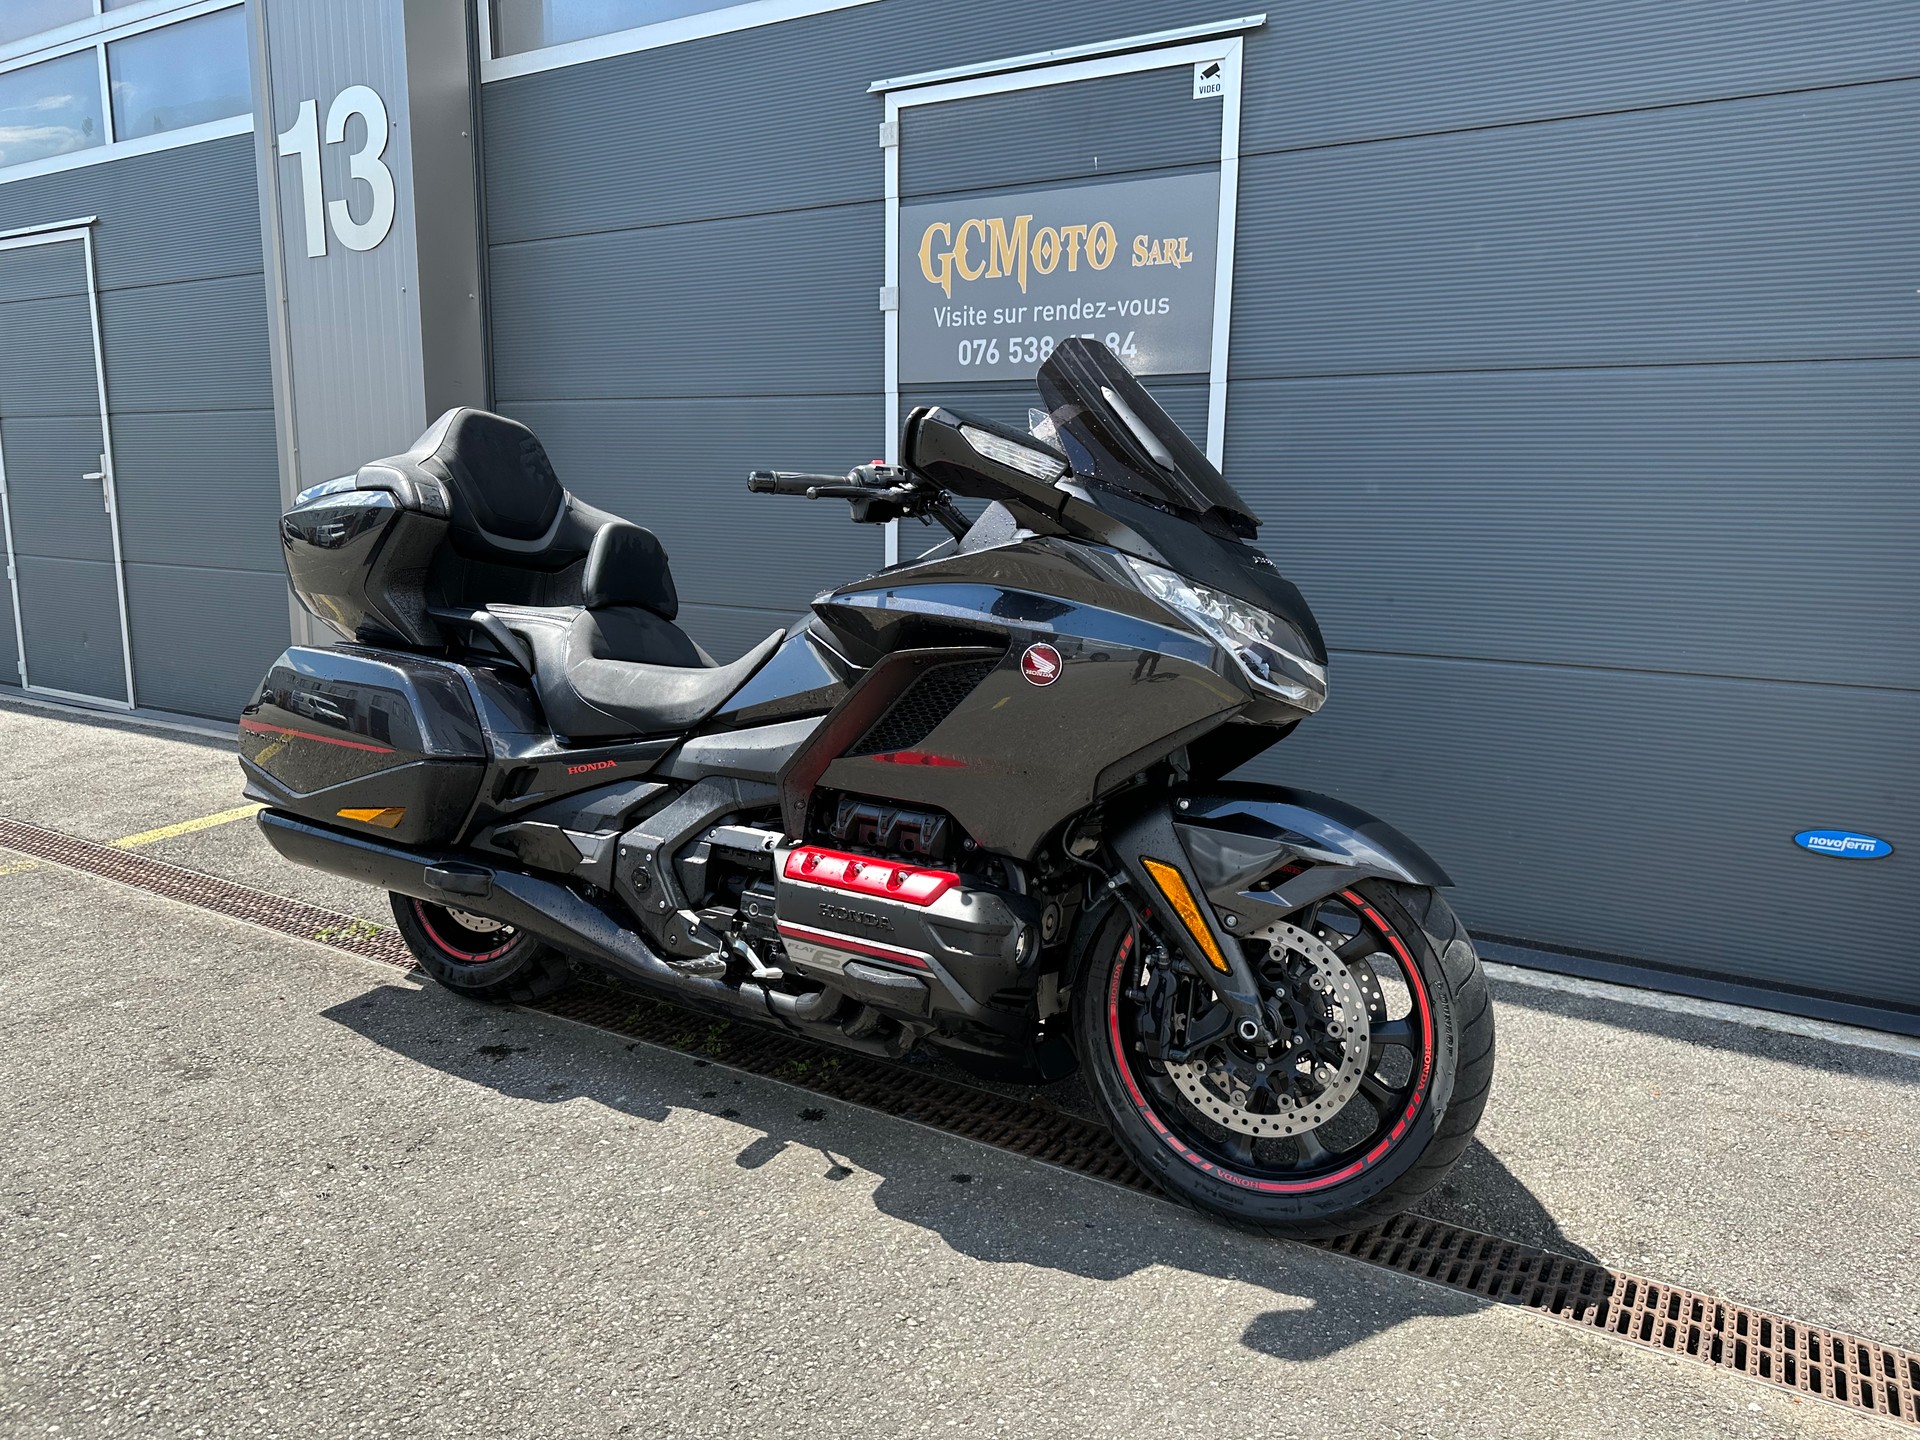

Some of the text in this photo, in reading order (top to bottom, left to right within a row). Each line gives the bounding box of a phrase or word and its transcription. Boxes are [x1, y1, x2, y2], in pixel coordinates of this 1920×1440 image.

[1198, 83, 1221, 94] VIDEO
[278, 84, 395, 258] 13
[933, 297, 1170, 328] Visite sur rendez-vous
[958, 338, 1000, 366] 076
[1008, 335, 1055, 363] 538
[1025, 669, 1054, 678] HONDA
[567, 760, 618, 775] HONDA
[1808, 836, 1876, 852] novoferm
[818, 902, 895, 931] HONDA
[787, 942, 842, 968] FLAT 6
[1110, 963, 1123, 1002] HONDA
[1418, 1043, 1432, 1090] HONDA
[1216, 1168, 1260, 1188] HONDA
